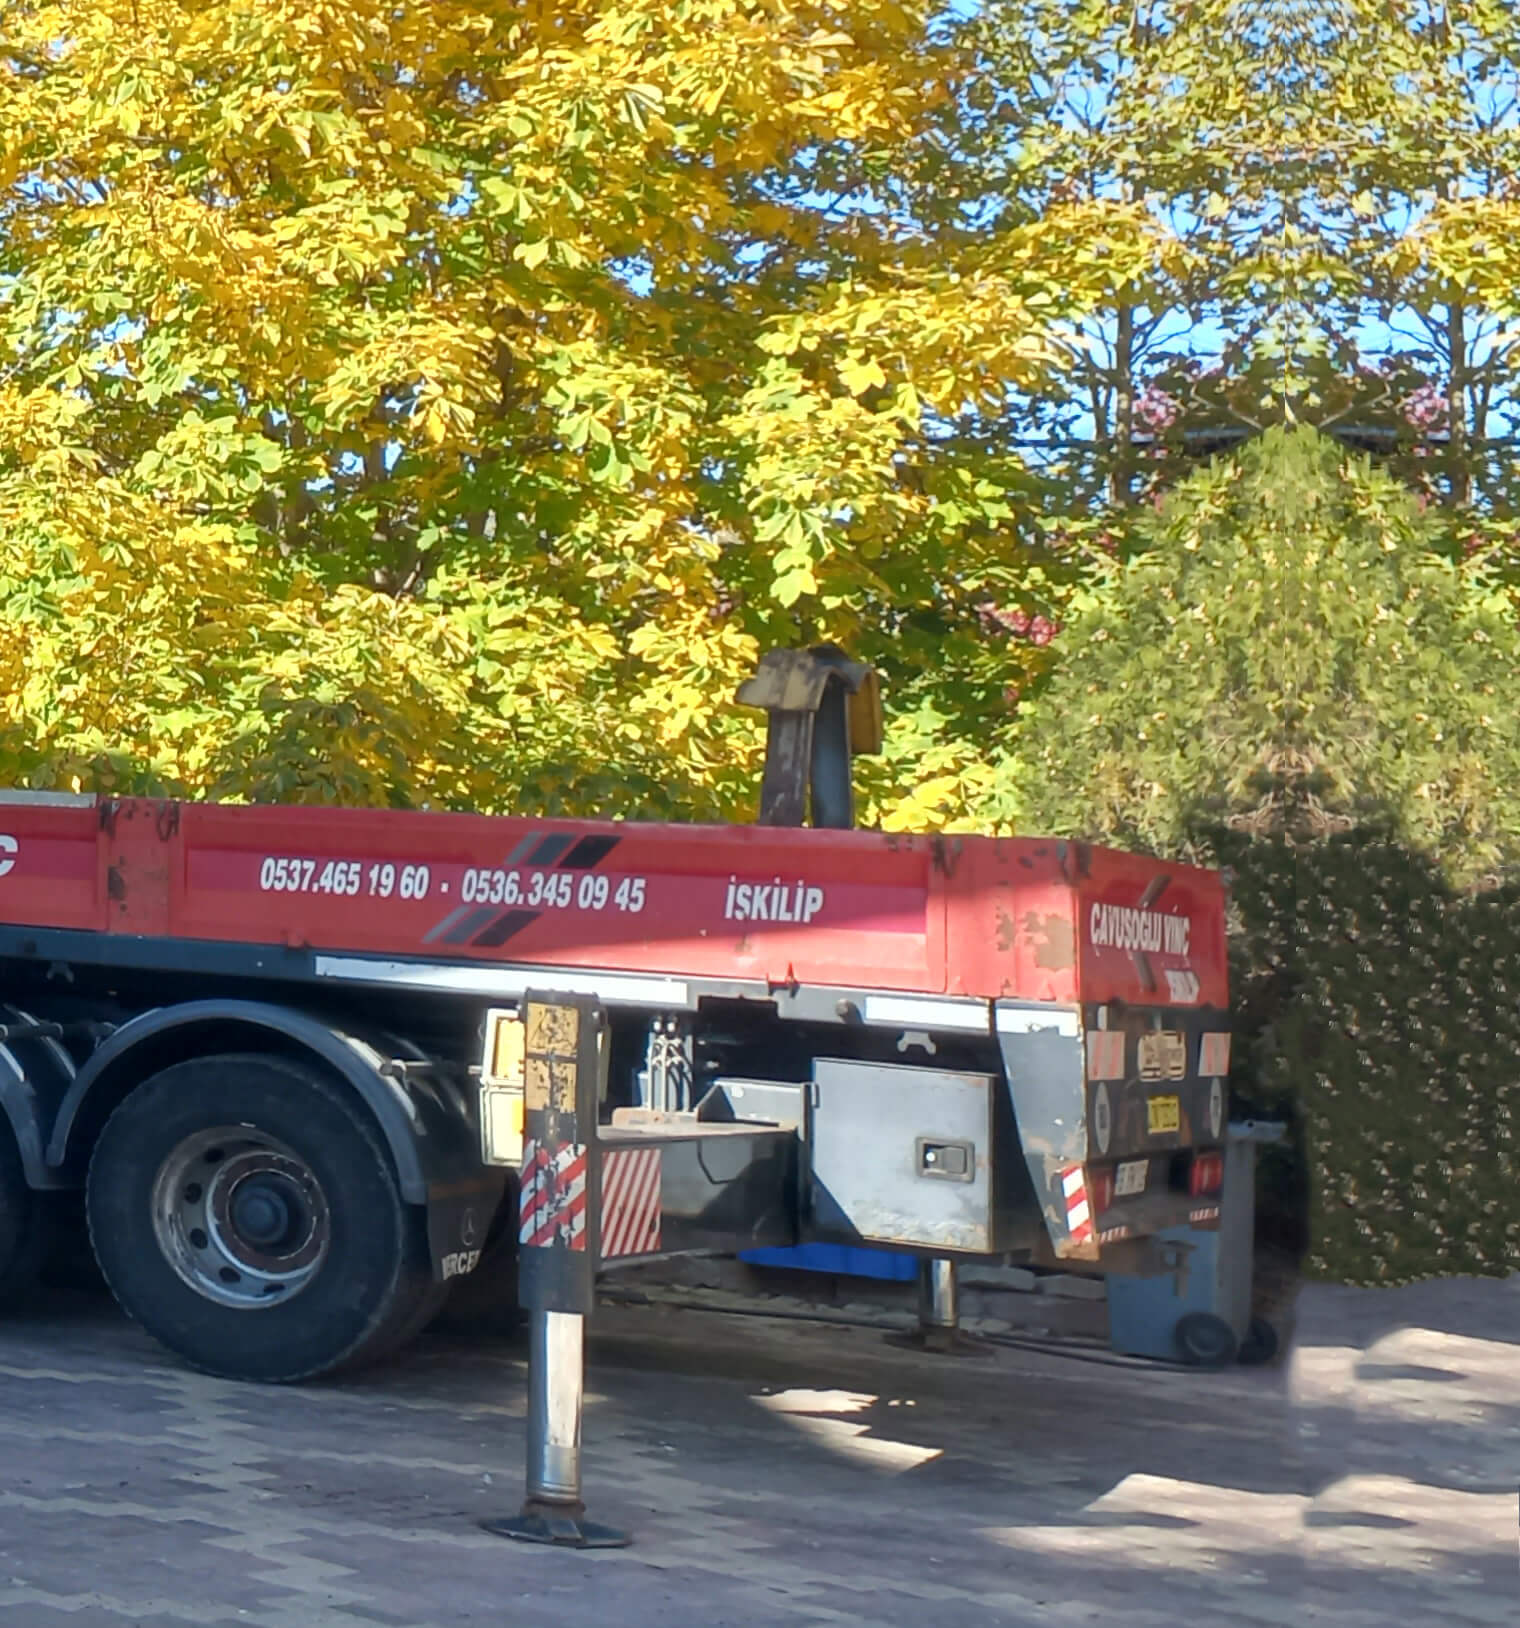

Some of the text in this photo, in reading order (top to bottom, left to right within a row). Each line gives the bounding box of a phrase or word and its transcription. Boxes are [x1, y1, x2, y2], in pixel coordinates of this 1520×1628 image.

[260, 857, 361, 896] 0537.465
[368, 864, 395, 898] 19
[399, 866, 430, 900] 60
[461, 868, 572, 909] 0536.345
[577, 872, 609, 911] 09
[613, 876, 646, 912] 45
[724, 874, 824, 923] İSKİLİP
